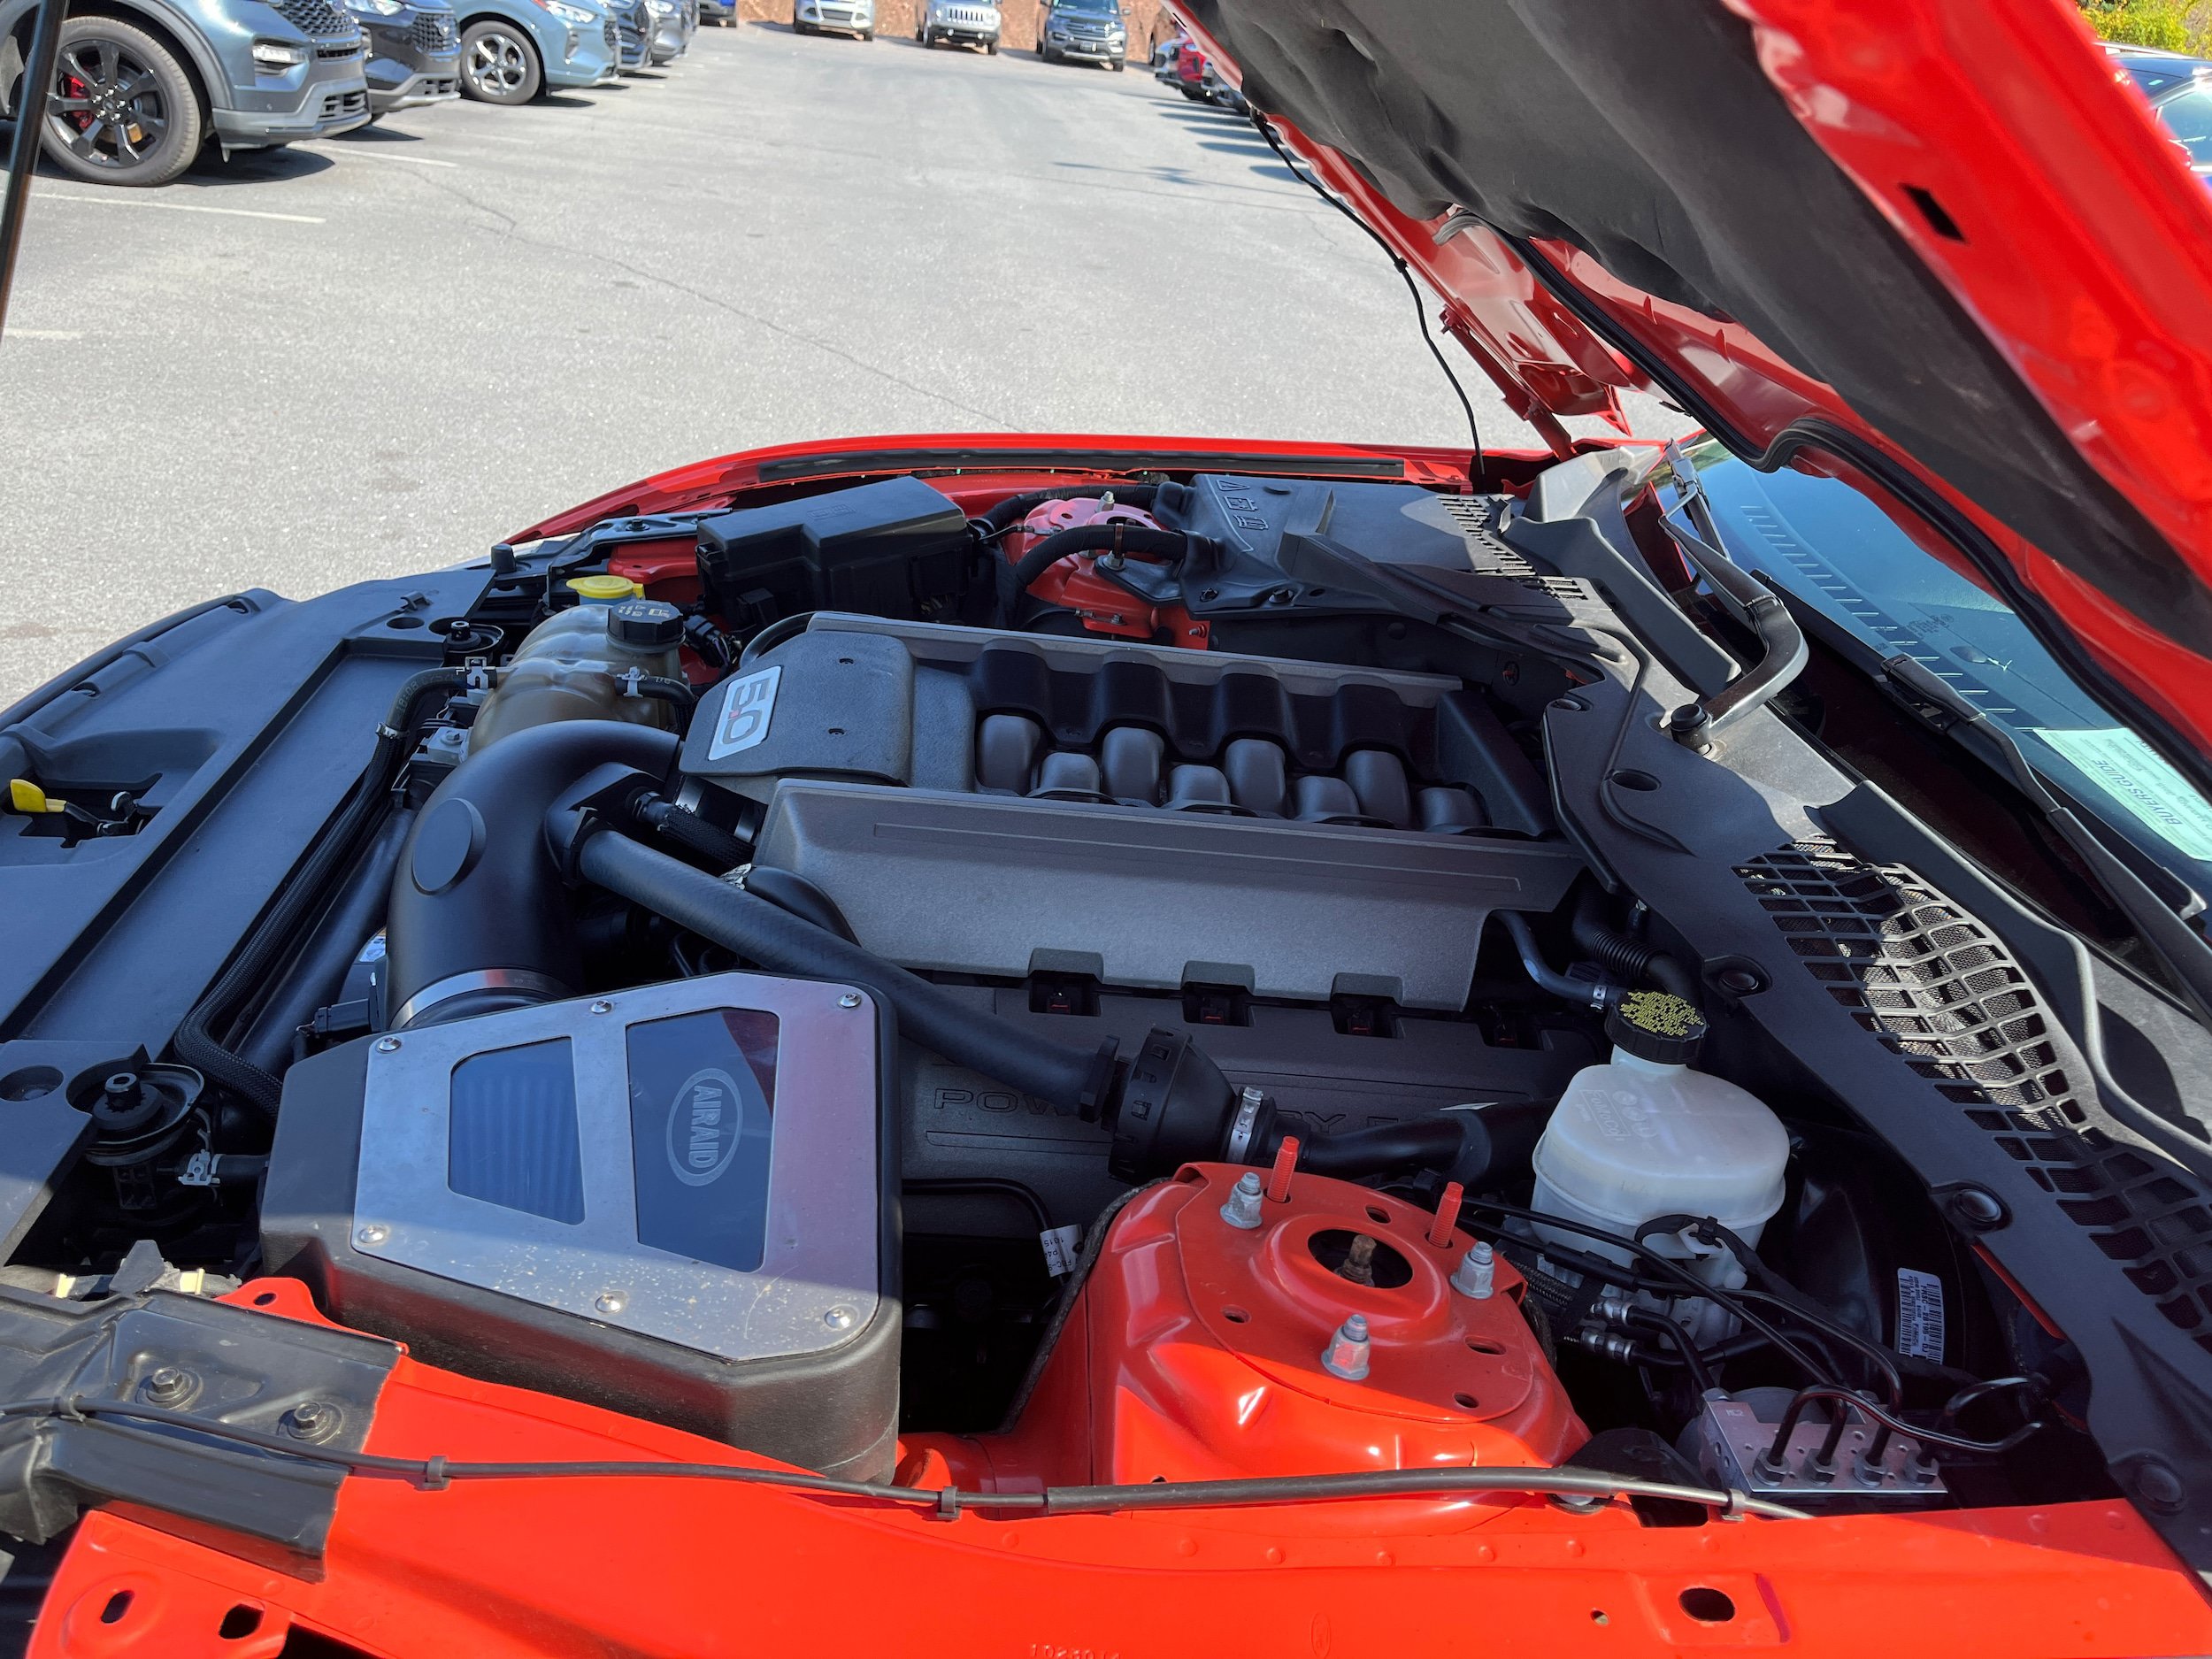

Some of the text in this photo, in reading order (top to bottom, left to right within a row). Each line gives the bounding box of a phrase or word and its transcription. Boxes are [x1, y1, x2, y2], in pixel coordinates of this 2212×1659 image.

[722, 678, 772, 744] 5.0
[2093, 759, 2132, 787] GUIDE
[2128, 787, 2183, 825] BUYERS
[688, 1085, 723, 1168] AIRAID
